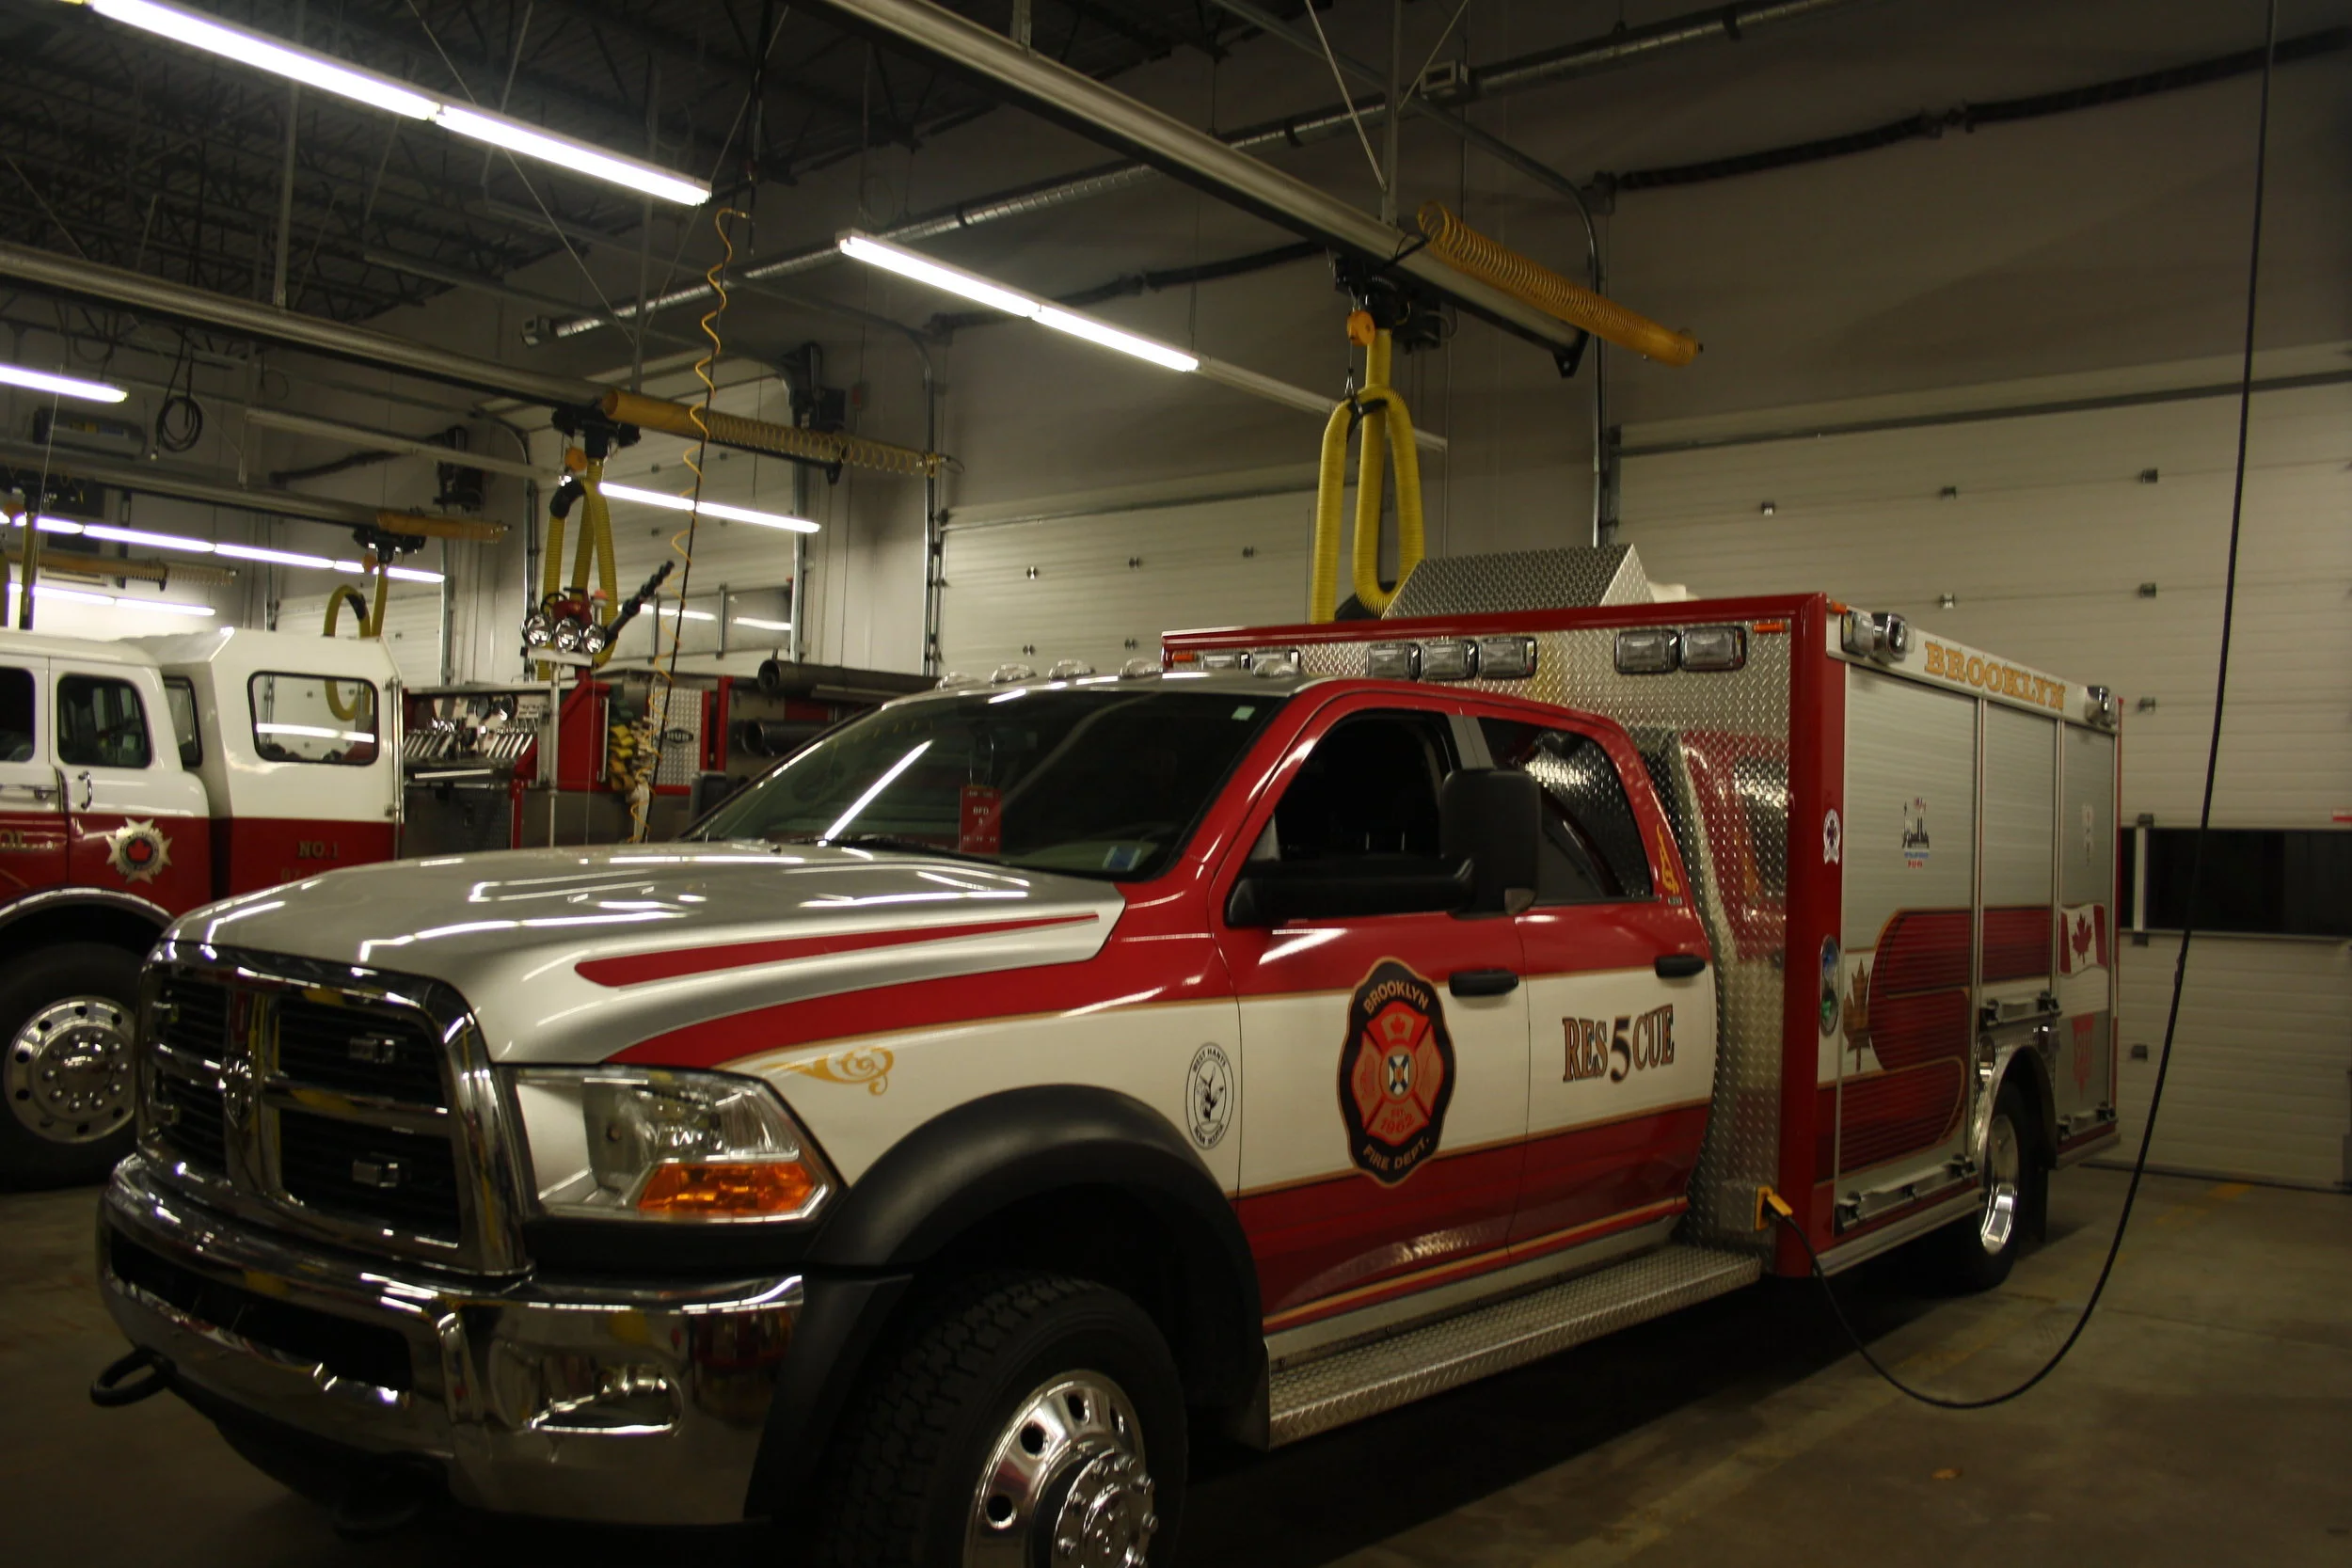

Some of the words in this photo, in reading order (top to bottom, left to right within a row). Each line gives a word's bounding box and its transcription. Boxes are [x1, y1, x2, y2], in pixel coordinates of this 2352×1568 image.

[1924, 641, 2066, 711] BROOKLYN
[1362, 979, 1430, 1016] BROOKLYN
[1192, 1049, 1206, 1072] WEST
[1362, 1143, 1391, 1171] FIRE
[1392, 1135, 1430, 1171] DEPT.
